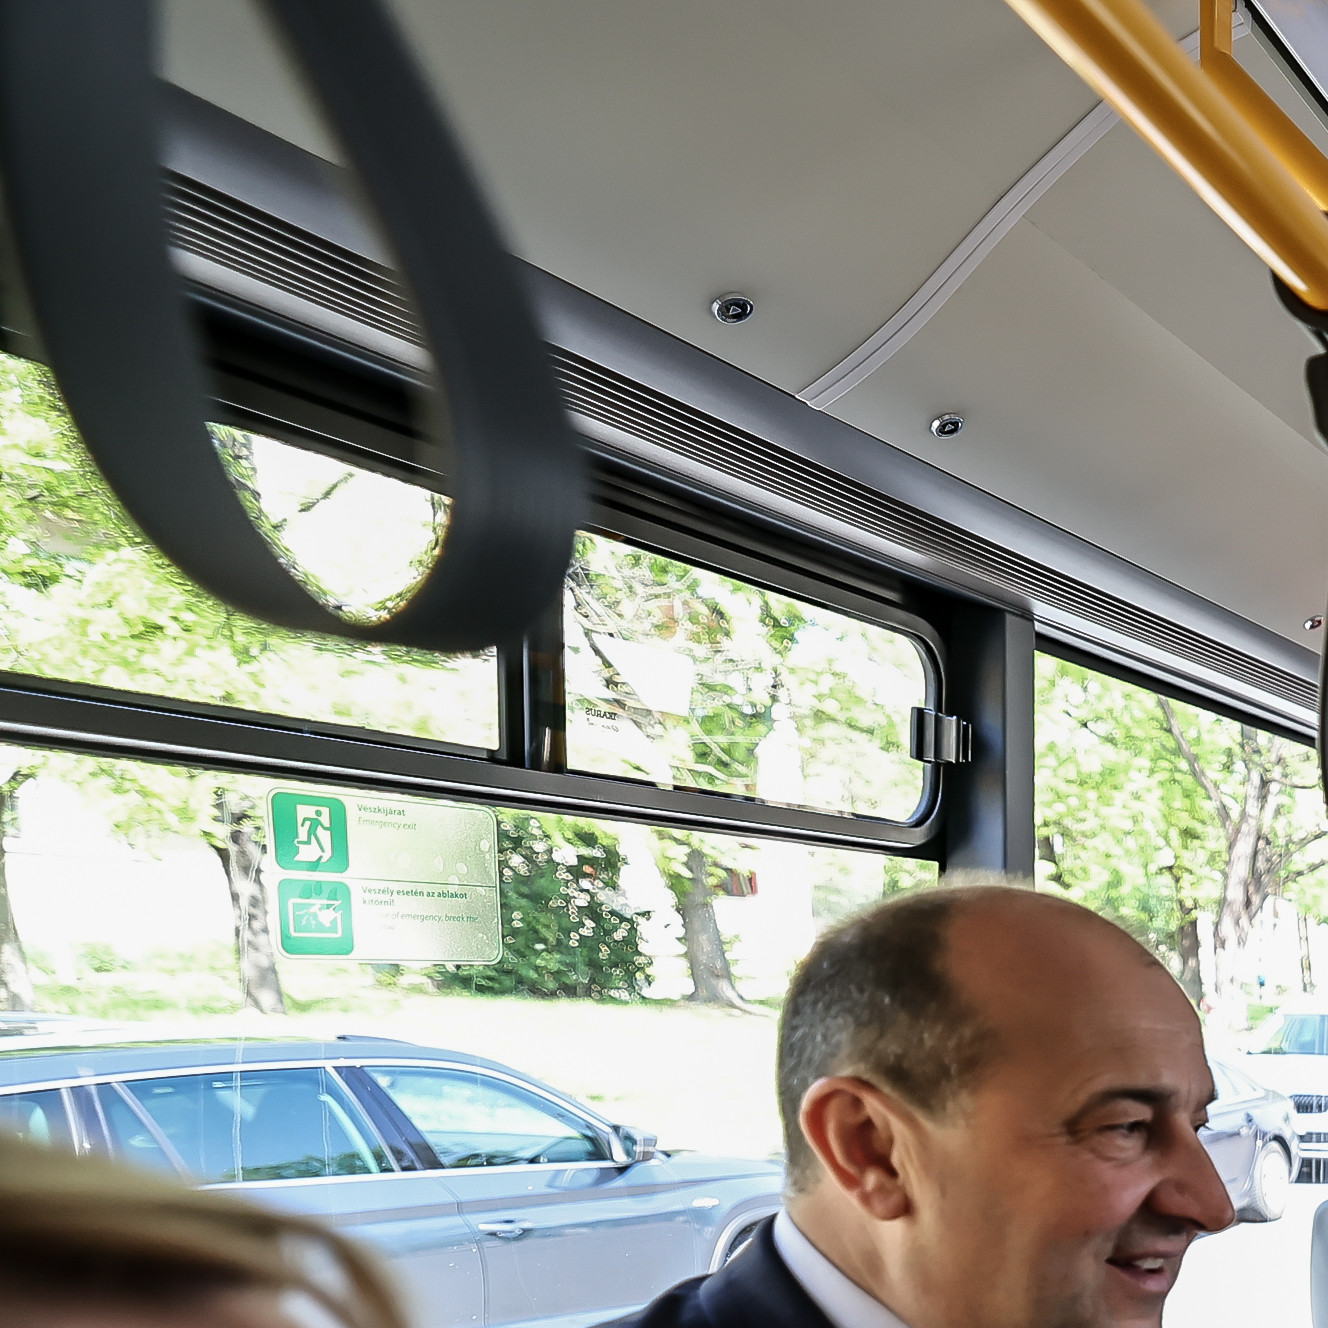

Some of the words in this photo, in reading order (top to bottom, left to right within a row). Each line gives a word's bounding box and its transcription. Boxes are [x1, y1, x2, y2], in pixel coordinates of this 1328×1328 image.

[358, 817, 402, 830] Emergency
[403, 822, 417, 831] exit
[361, 886, 394, 897] Veszély
[396, 889, 424, 897] esetén
[437, 890, 468, 899] ablakot
[400, 912, 443, 923] emergency,
[445, 914, 464, 922] break
